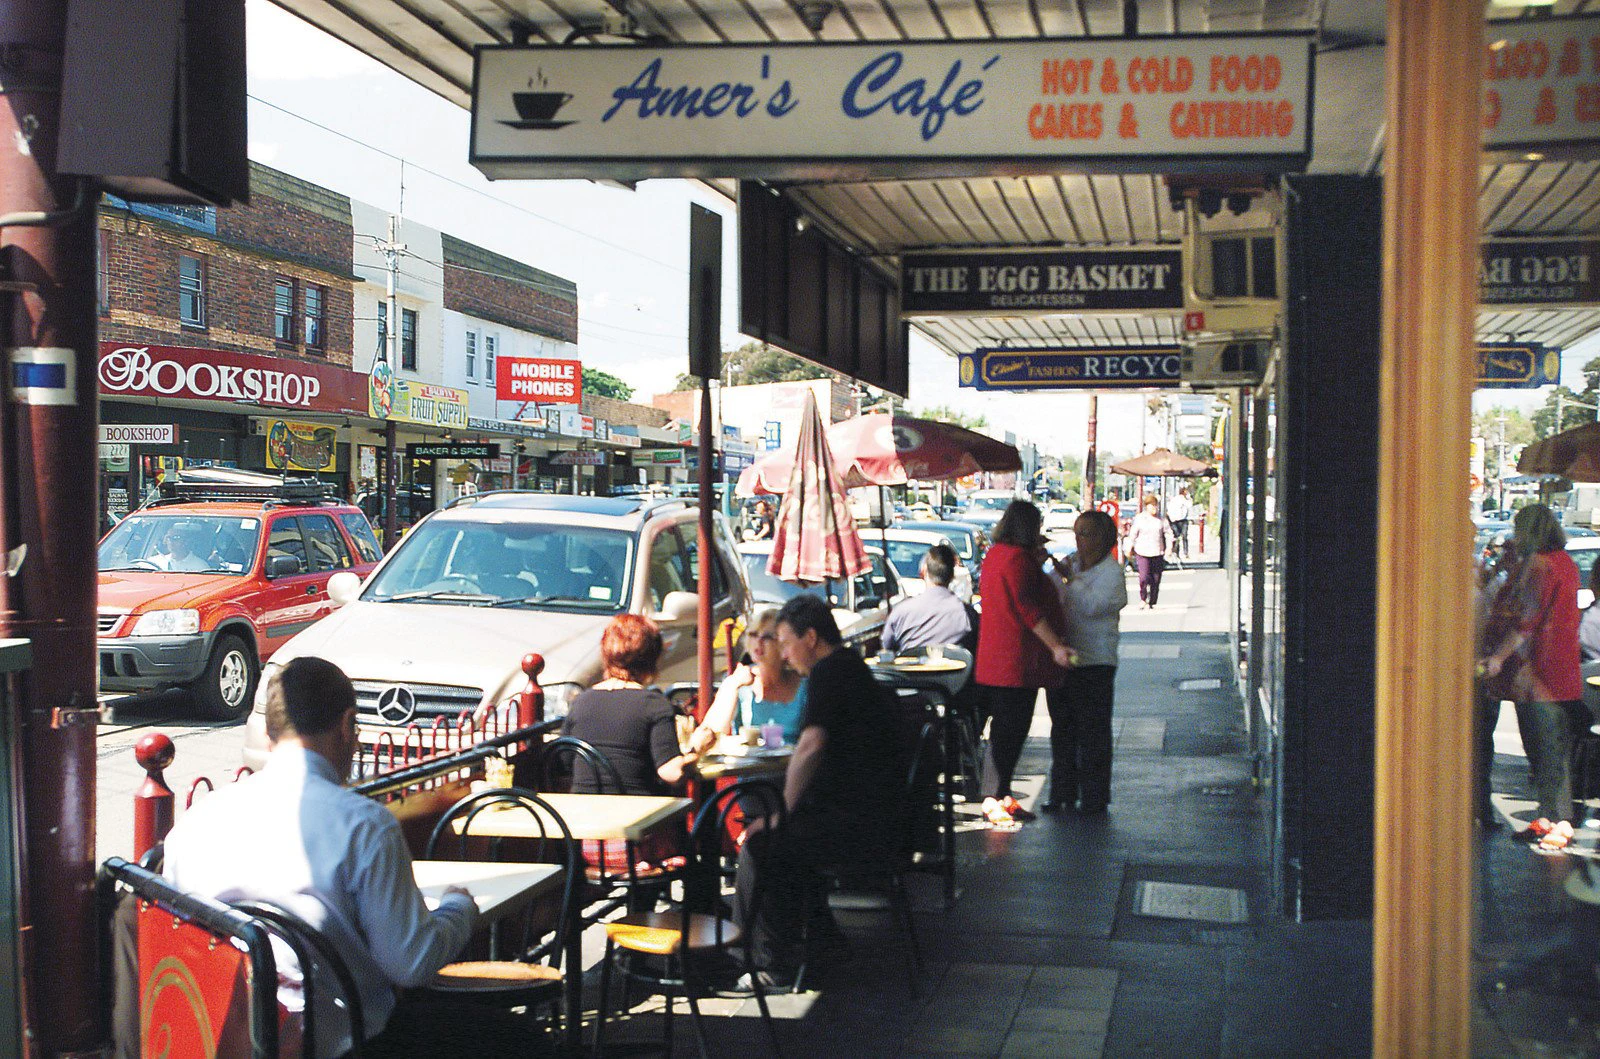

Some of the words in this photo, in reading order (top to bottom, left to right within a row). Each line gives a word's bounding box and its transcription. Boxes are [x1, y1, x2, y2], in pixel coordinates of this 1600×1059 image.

[1042, 57, 1094, 95] HOT
[1100, 56, 1120, 94] &
[1127, 56, 1194, 94] COLD
[1209, 54, 1283, 93] FOOD
[602, 55, 798, 122] Amer's
[840, 51, 1000, 141] Café
[1028, 103, 1103, 140] CAKES
[1118, 103, 1139, 139] &
[1169, 100, 1295, 138] CATERING
[908, 265, 968, 292] THE
[978, 264, 1040, 292] EGG
[1047, 263, 1171, 291] BASKET
[991, 294, 1086, 307] DELICATESSEN
[511, 363, 575, 380] MOBILE
[511, 380, 575, 397] PHONES
[410, 397, 435, 423] FRUIT
[436, 401, 467, 427] SUPPLY
[106, 427, 169, 441] BOOKSHOP
[415, 447, 449, 455] BAKER
[450, 447, 458, 455] &
[460, 447, 488, 455] SPICE
